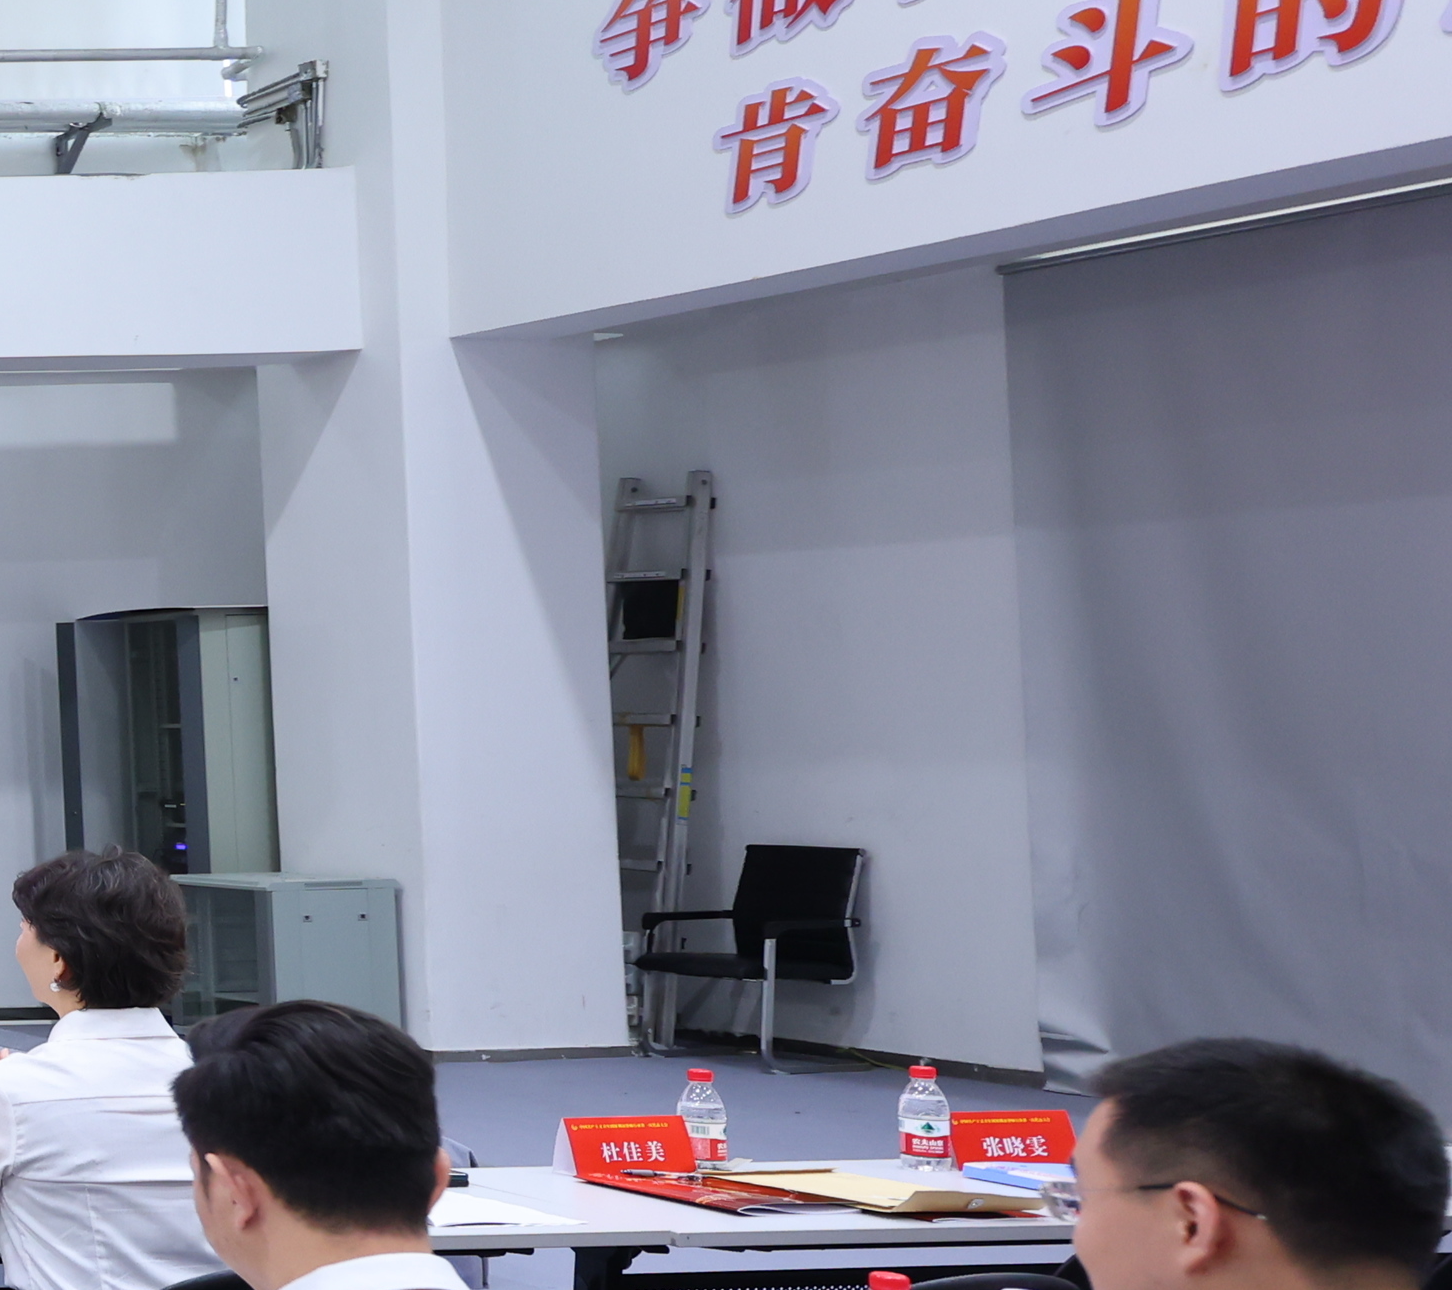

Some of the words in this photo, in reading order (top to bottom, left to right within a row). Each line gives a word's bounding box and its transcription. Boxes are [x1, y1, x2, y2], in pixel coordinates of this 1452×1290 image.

[601, 1140, 665, 1163] 杜佳美
[981, 1135, 1049, 1158] 张晓雯
